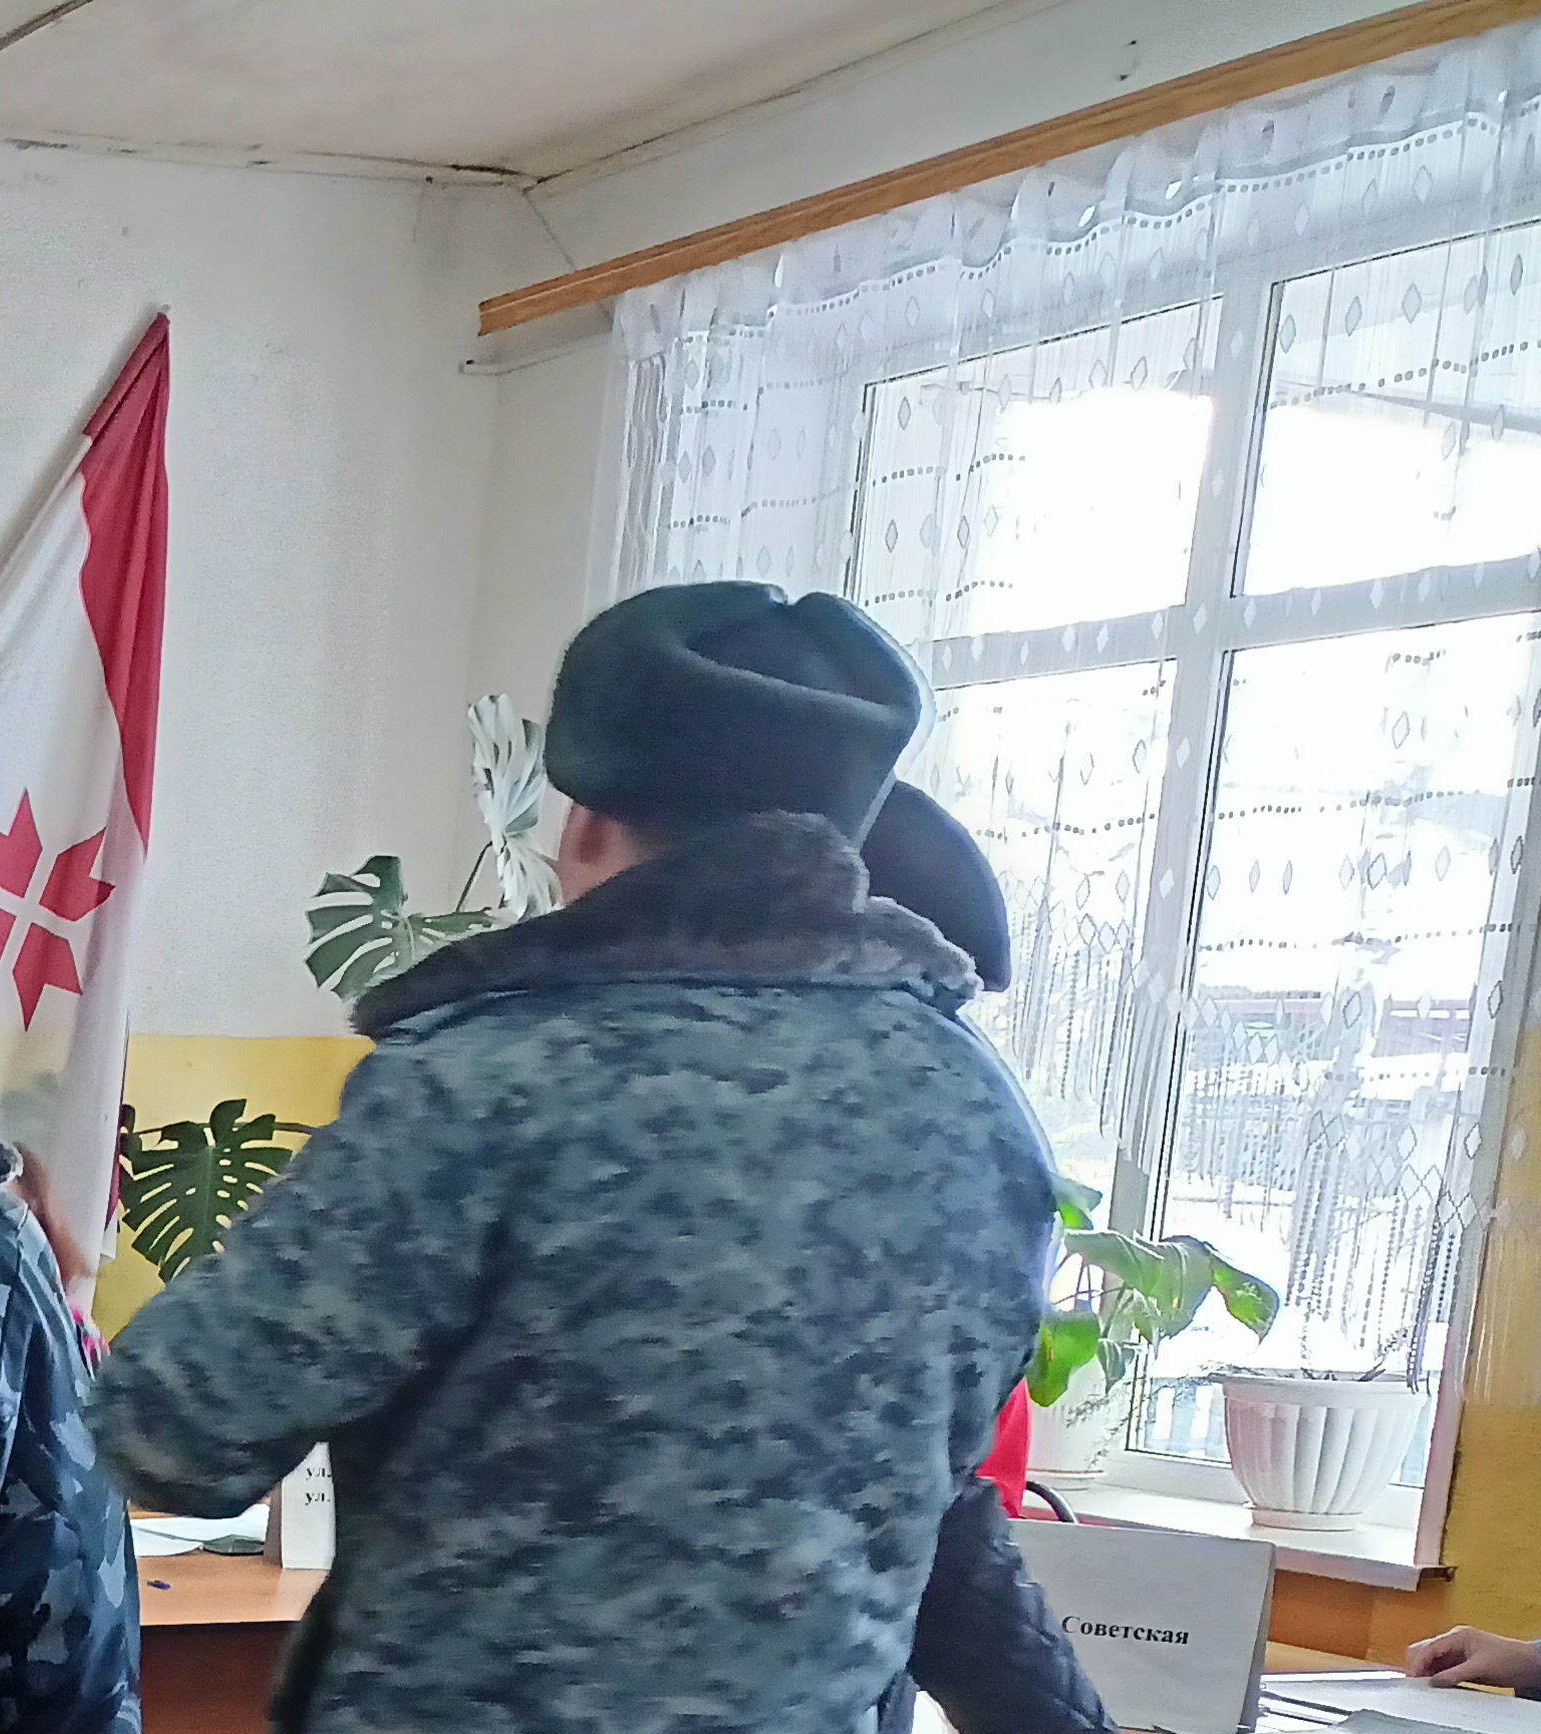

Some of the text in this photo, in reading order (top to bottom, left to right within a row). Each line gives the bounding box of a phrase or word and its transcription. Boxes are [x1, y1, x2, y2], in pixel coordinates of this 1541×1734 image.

[306, 1466, 333, 1481] ул.
[304, 1490, 331, 1505] ул.
[1061, 1614, 1189, 1645] Советская
